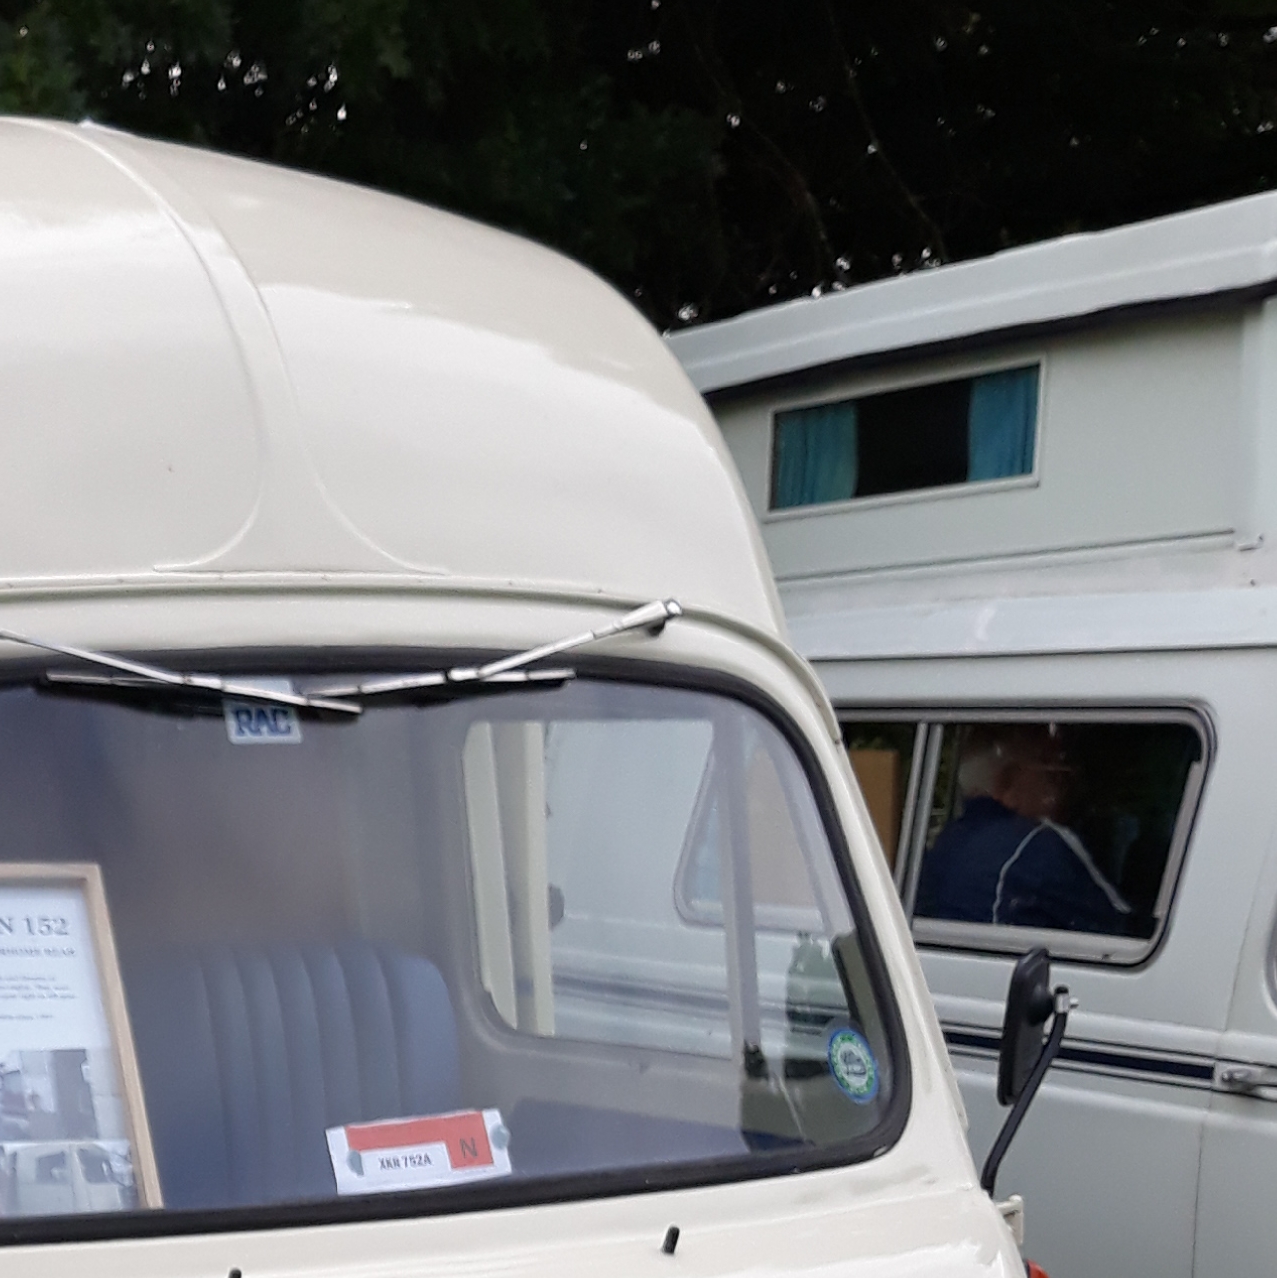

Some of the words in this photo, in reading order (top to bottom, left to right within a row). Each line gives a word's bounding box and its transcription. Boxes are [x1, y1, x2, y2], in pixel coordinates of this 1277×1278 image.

[233, 707, 292, 737] RAC
[24, 916, 69, 936] 152
[459, 1137, 479, 1159] N
